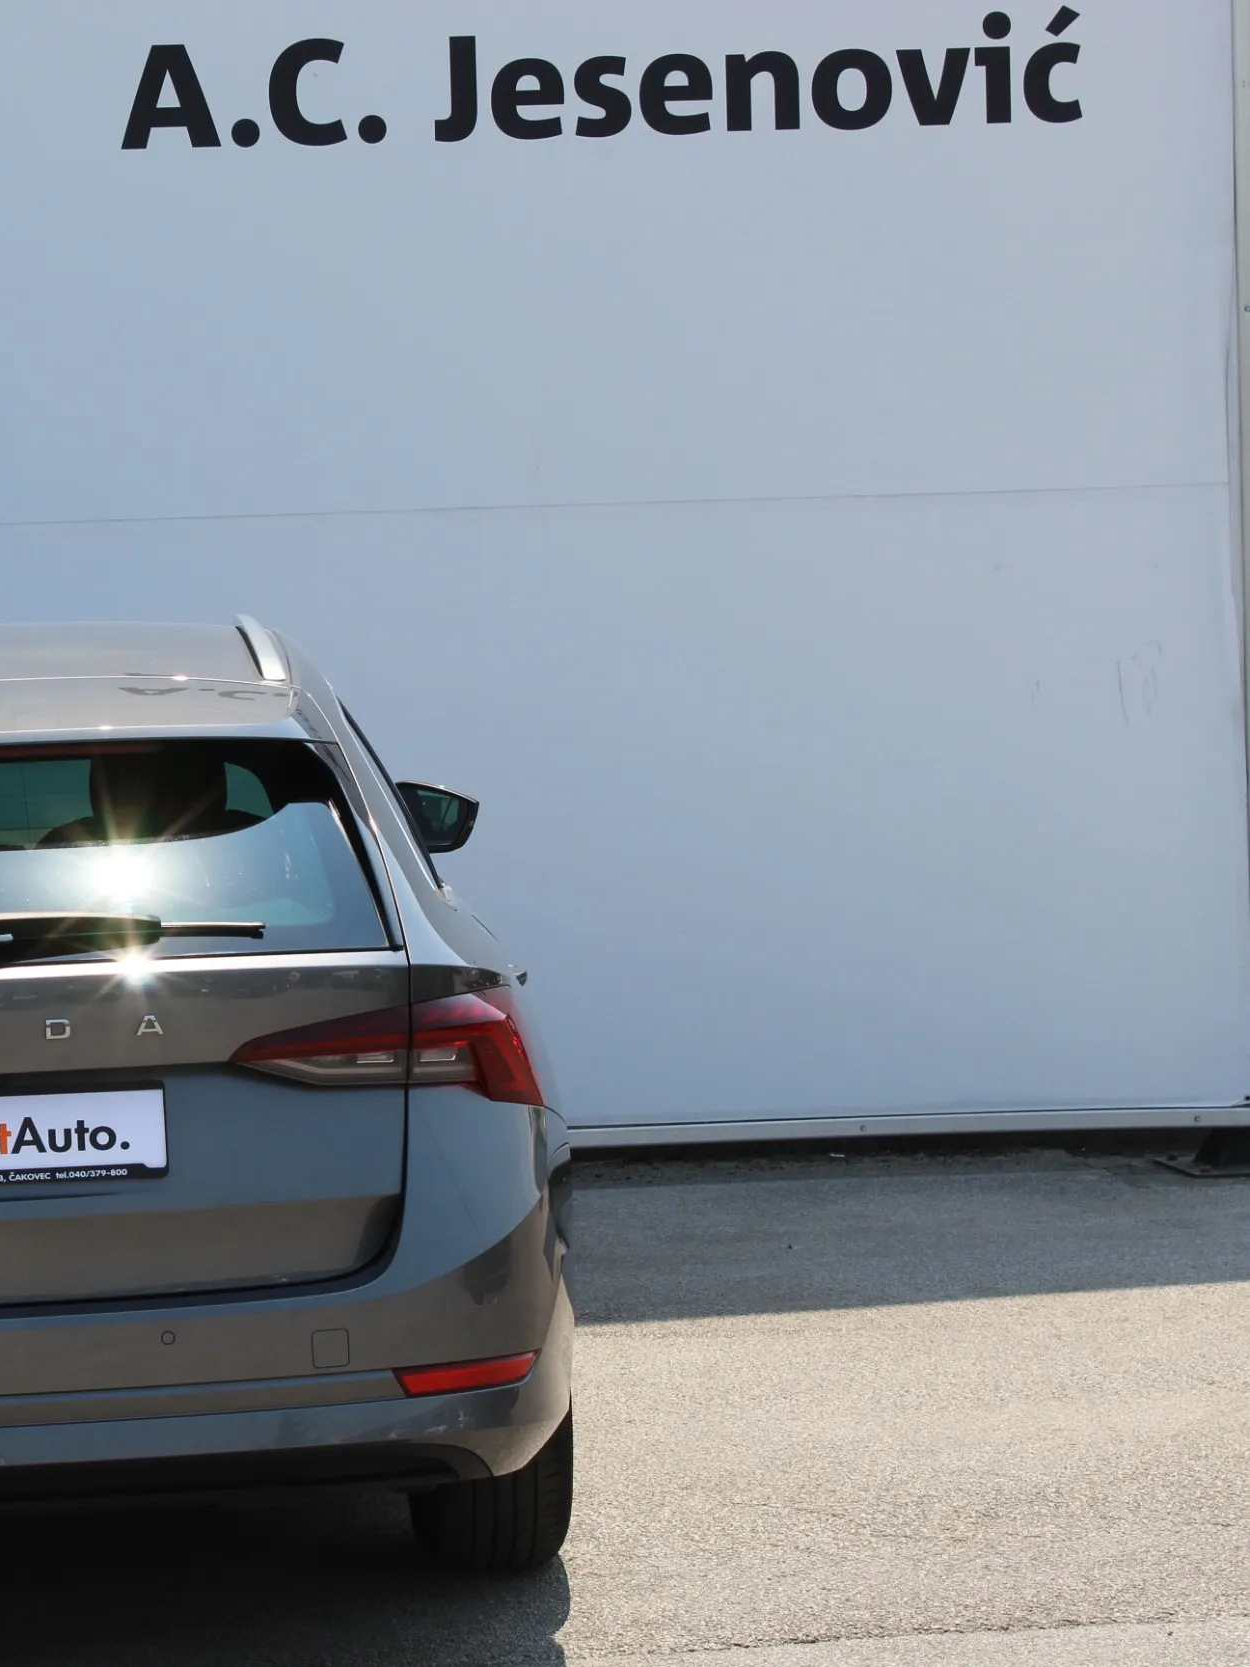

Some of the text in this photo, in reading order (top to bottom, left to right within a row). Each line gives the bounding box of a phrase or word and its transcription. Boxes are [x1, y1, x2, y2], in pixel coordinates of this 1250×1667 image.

[121, 5, 1082, 150] A.C. Jesenović
[9, 1171, 51, 1182] ČAKOVEC
[55, 1168, 128, 1180] tel.040/379-800
